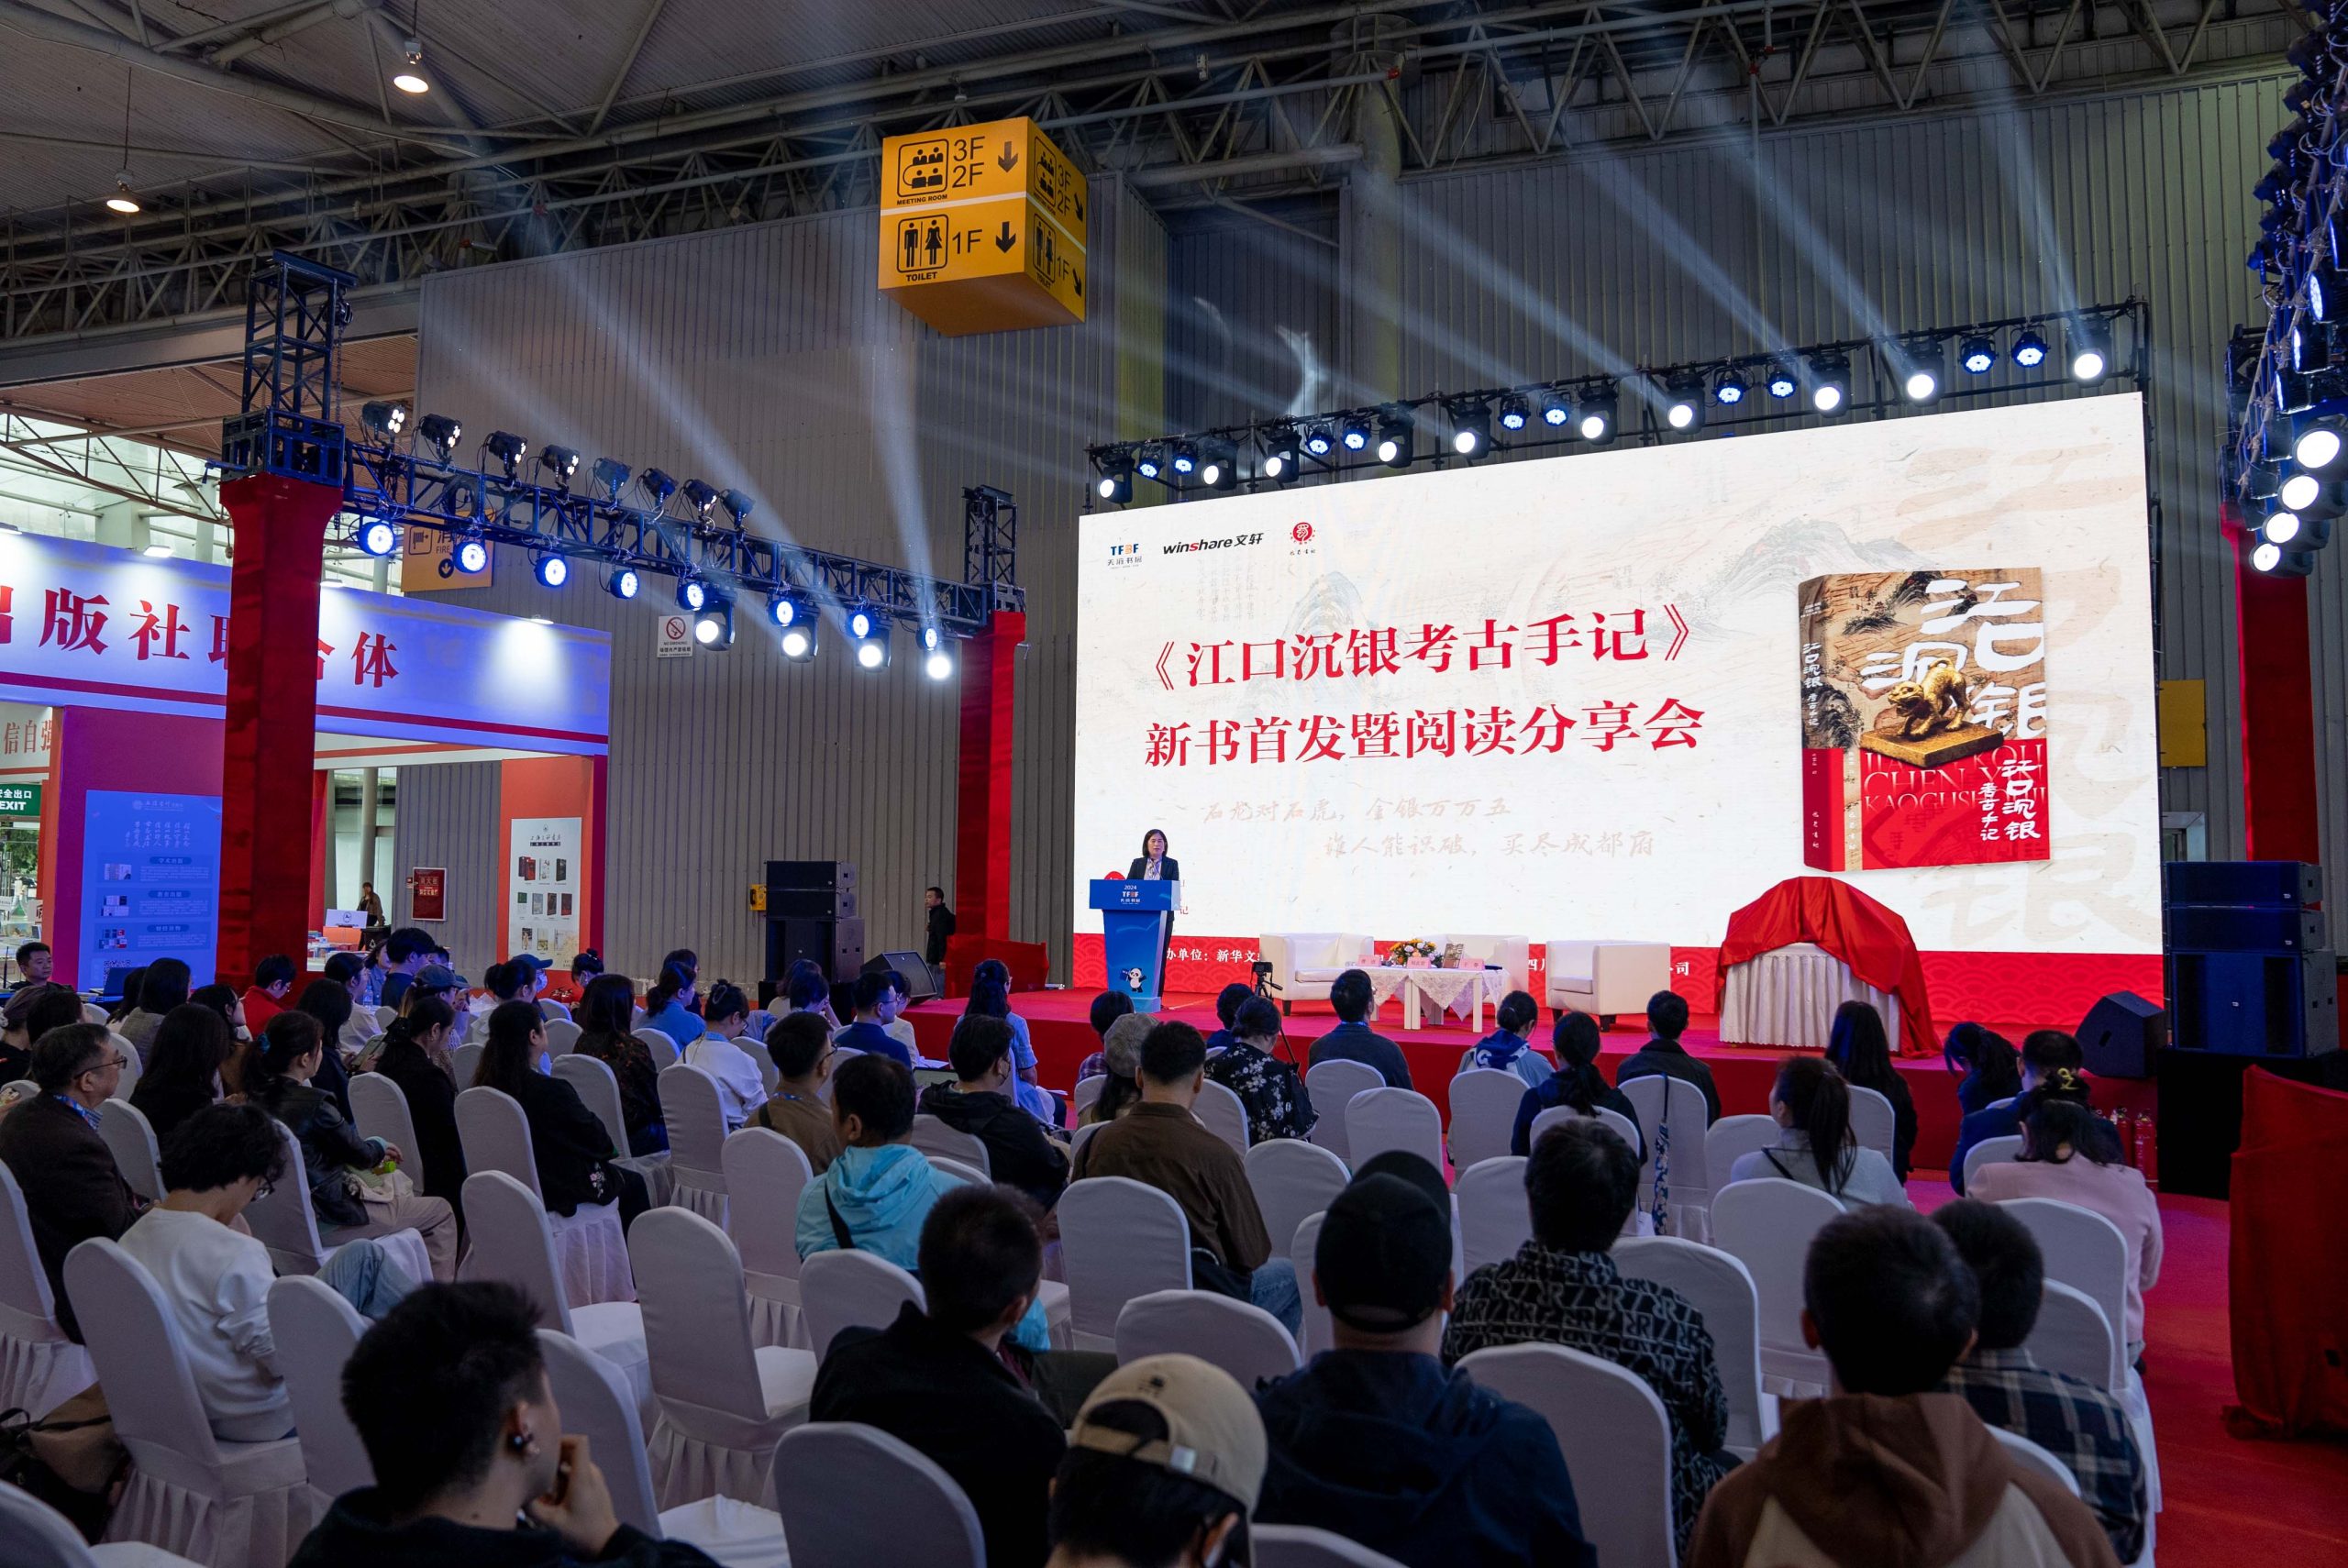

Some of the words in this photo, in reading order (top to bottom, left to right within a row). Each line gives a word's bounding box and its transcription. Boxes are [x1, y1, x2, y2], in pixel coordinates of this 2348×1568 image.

[953, 136, 985, 162] 3F
[952, 162, 984, 189] 2F
[1058, 164, 1071, 192] 3F
[896, 196, 926, 206] MEETING
[927, 193, 948, 203] ROOM
[1057, 189, 1071, 216] 2F
[952, 229, 983, 254] 1F
[905, 271, 938, 282] TOILET
[1057, 256, 1070, 281] 1F
[1163, 537, 1233, 555] winshare
[1234, 532, 1265, 547] 文轩
[0, 585, 399, 689] 版社体
[1155, 603, 1691, 690] 《江口沉银考古手记》
[1145, 697, 1706, 768] 新书首发暨阅读分享会
[0, 801, 27, 811] EXIT
[1978, 782, 2001, 842] 考古手记
[2001, 759, 2042, 841] 江口沉银
[1217, 948, 1260, 963] 新华文
